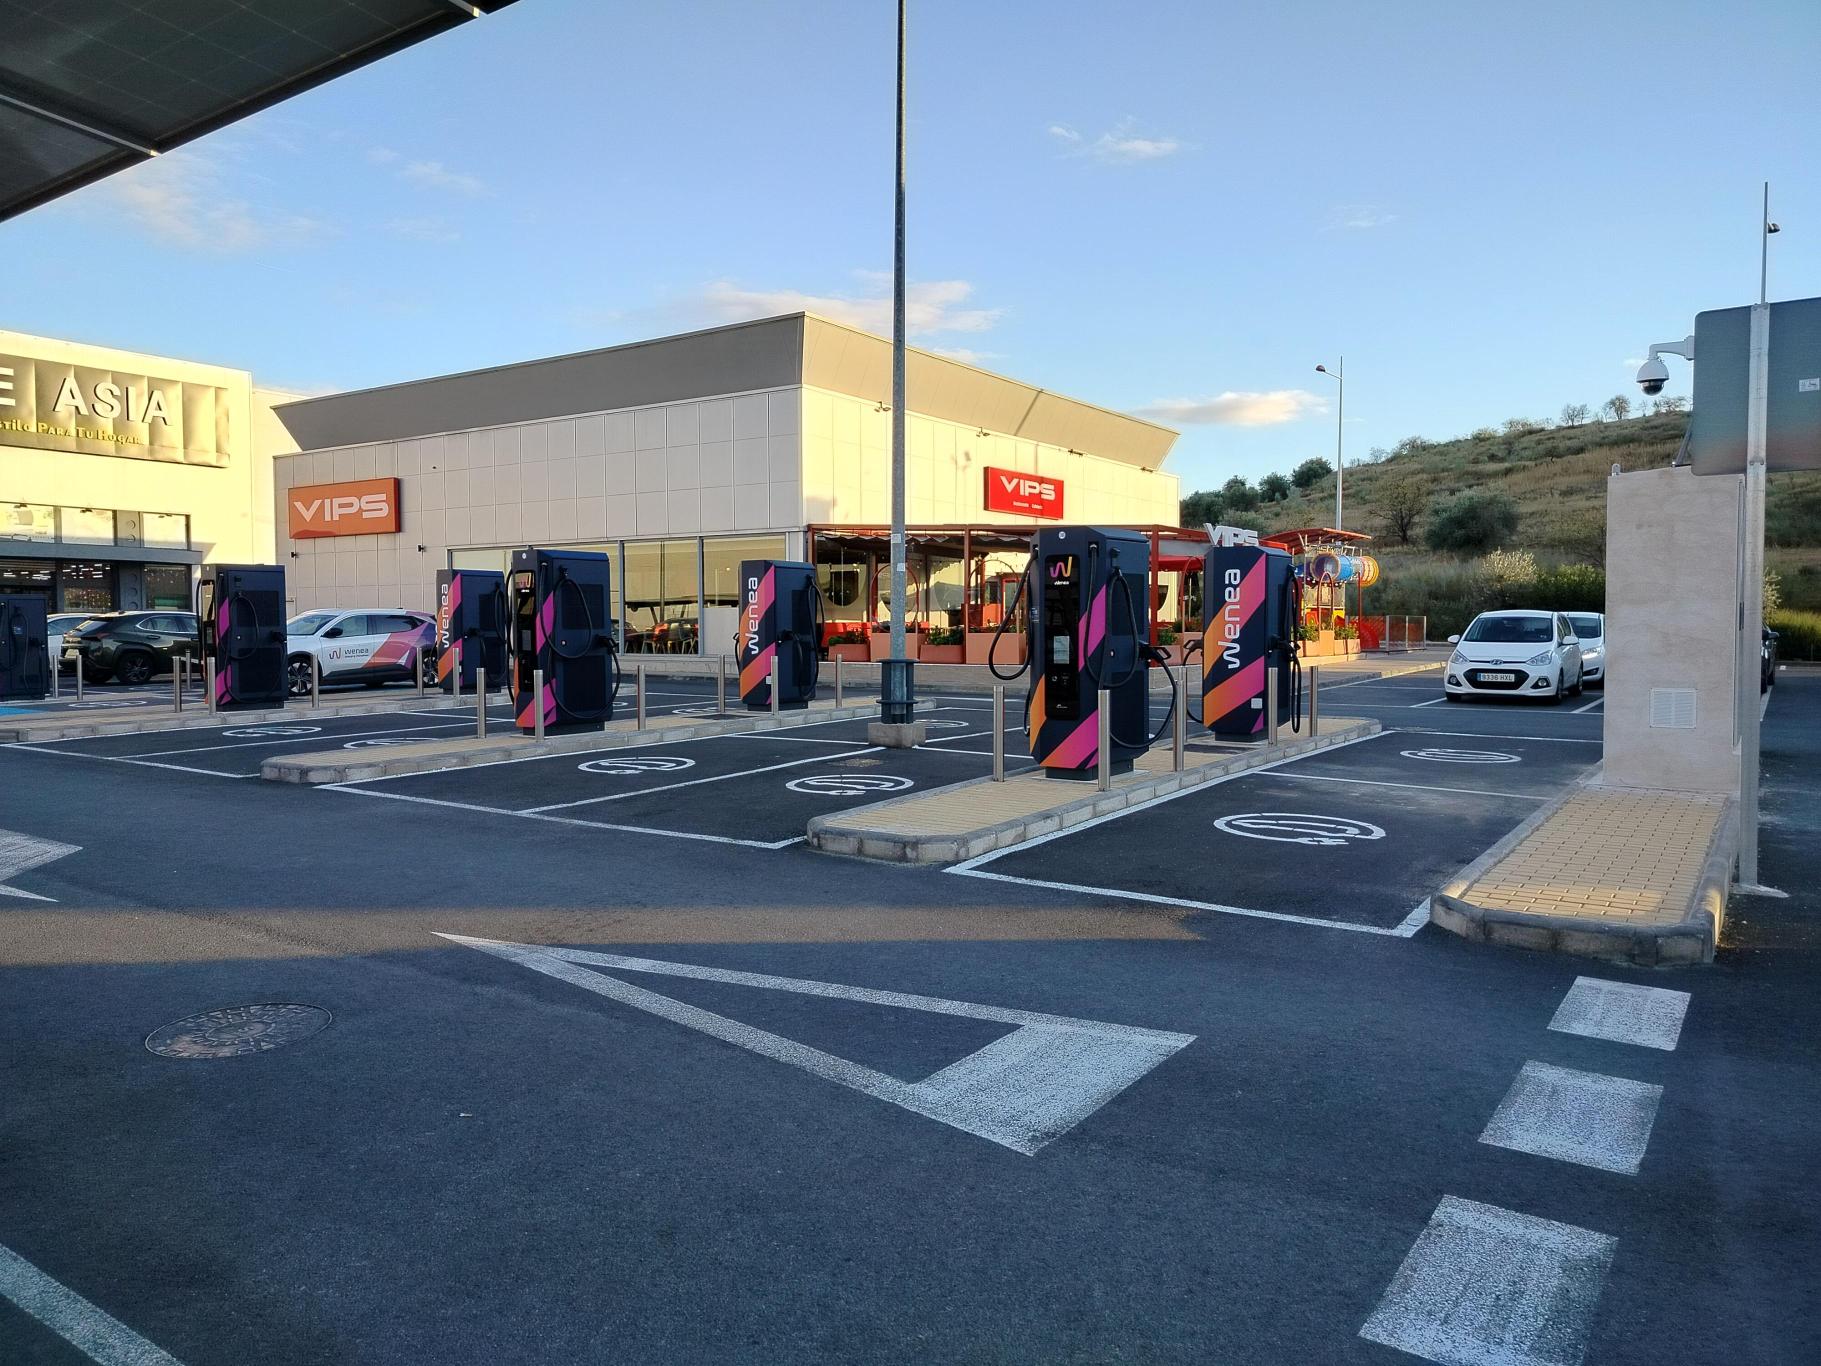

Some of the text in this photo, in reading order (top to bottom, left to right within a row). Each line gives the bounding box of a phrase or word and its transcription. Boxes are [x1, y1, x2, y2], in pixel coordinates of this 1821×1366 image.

[54, 377, 172, 426] ASIA
[1000, 475, 1056, 501] VIPS
[293, 493, 389, 522] VIPS
[1203, 522, 1259, 547] VIPS
